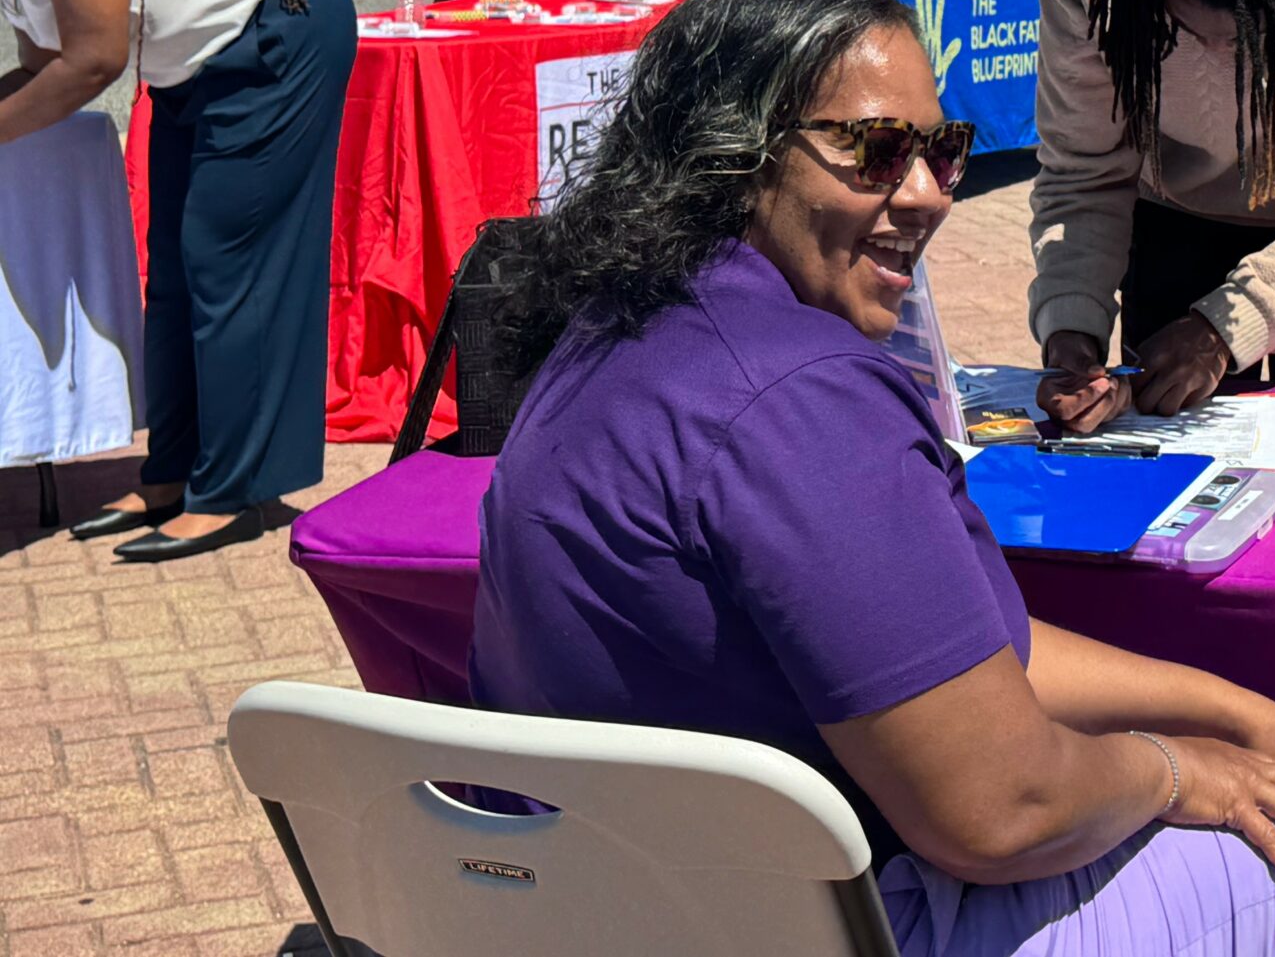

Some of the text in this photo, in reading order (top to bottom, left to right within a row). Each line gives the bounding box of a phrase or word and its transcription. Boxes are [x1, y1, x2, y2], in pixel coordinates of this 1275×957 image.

[970, 21, 1016, 50] BLACK
[971, 51, 1039, 84] BLUEPRINT
[586, 69, 620, 95] THE
[468, 861, 526, 880] LIFETIME
